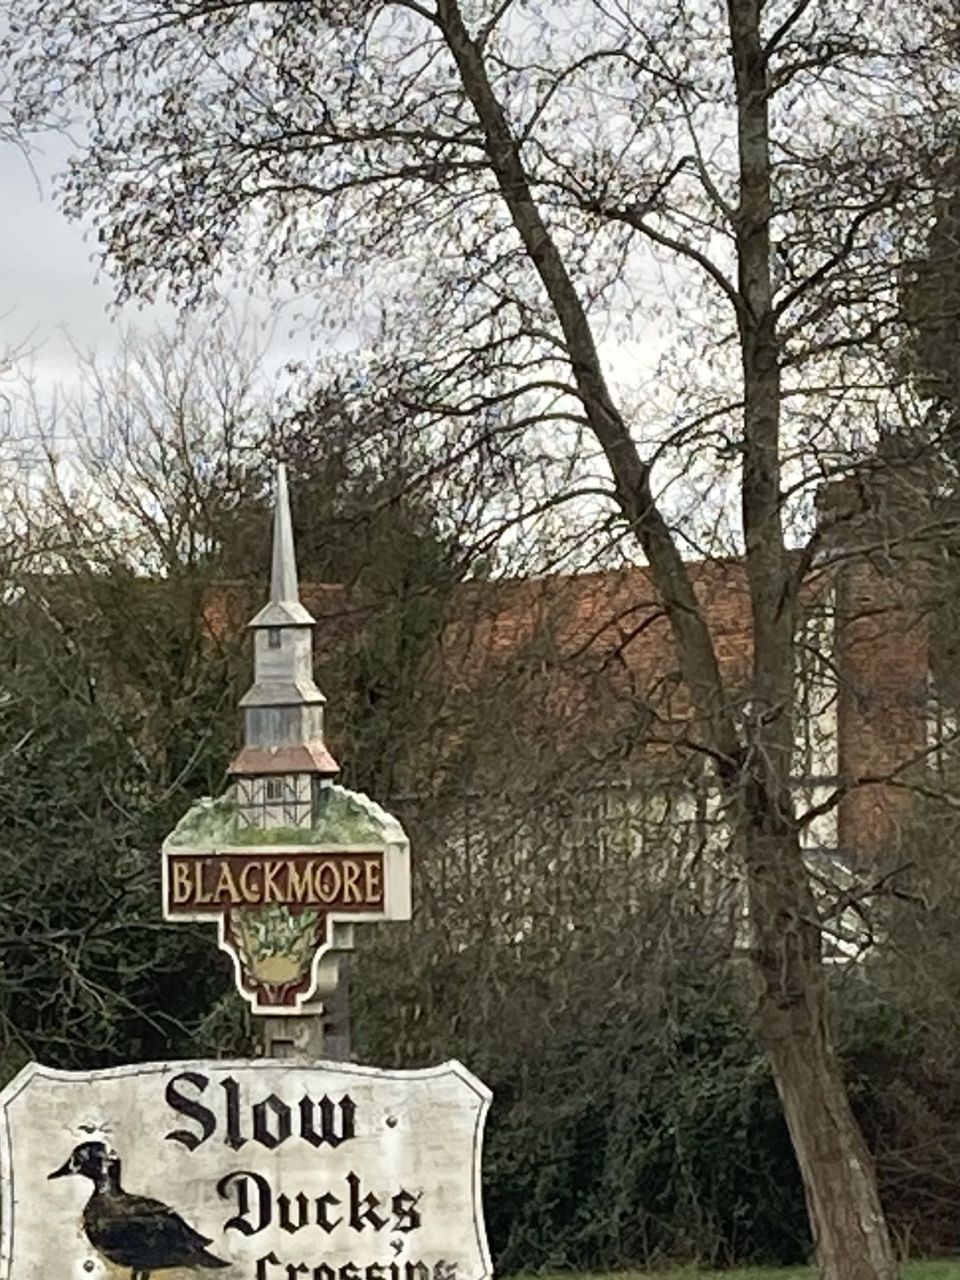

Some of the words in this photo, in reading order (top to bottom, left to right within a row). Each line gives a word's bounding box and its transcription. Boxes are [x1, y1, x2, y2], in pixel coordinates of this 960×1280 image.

[172, 860, 382, 903] BLACKMORE
[164, 1072, 357, 1152] Slow
[217, 1170, 423, 1236] Ducks
